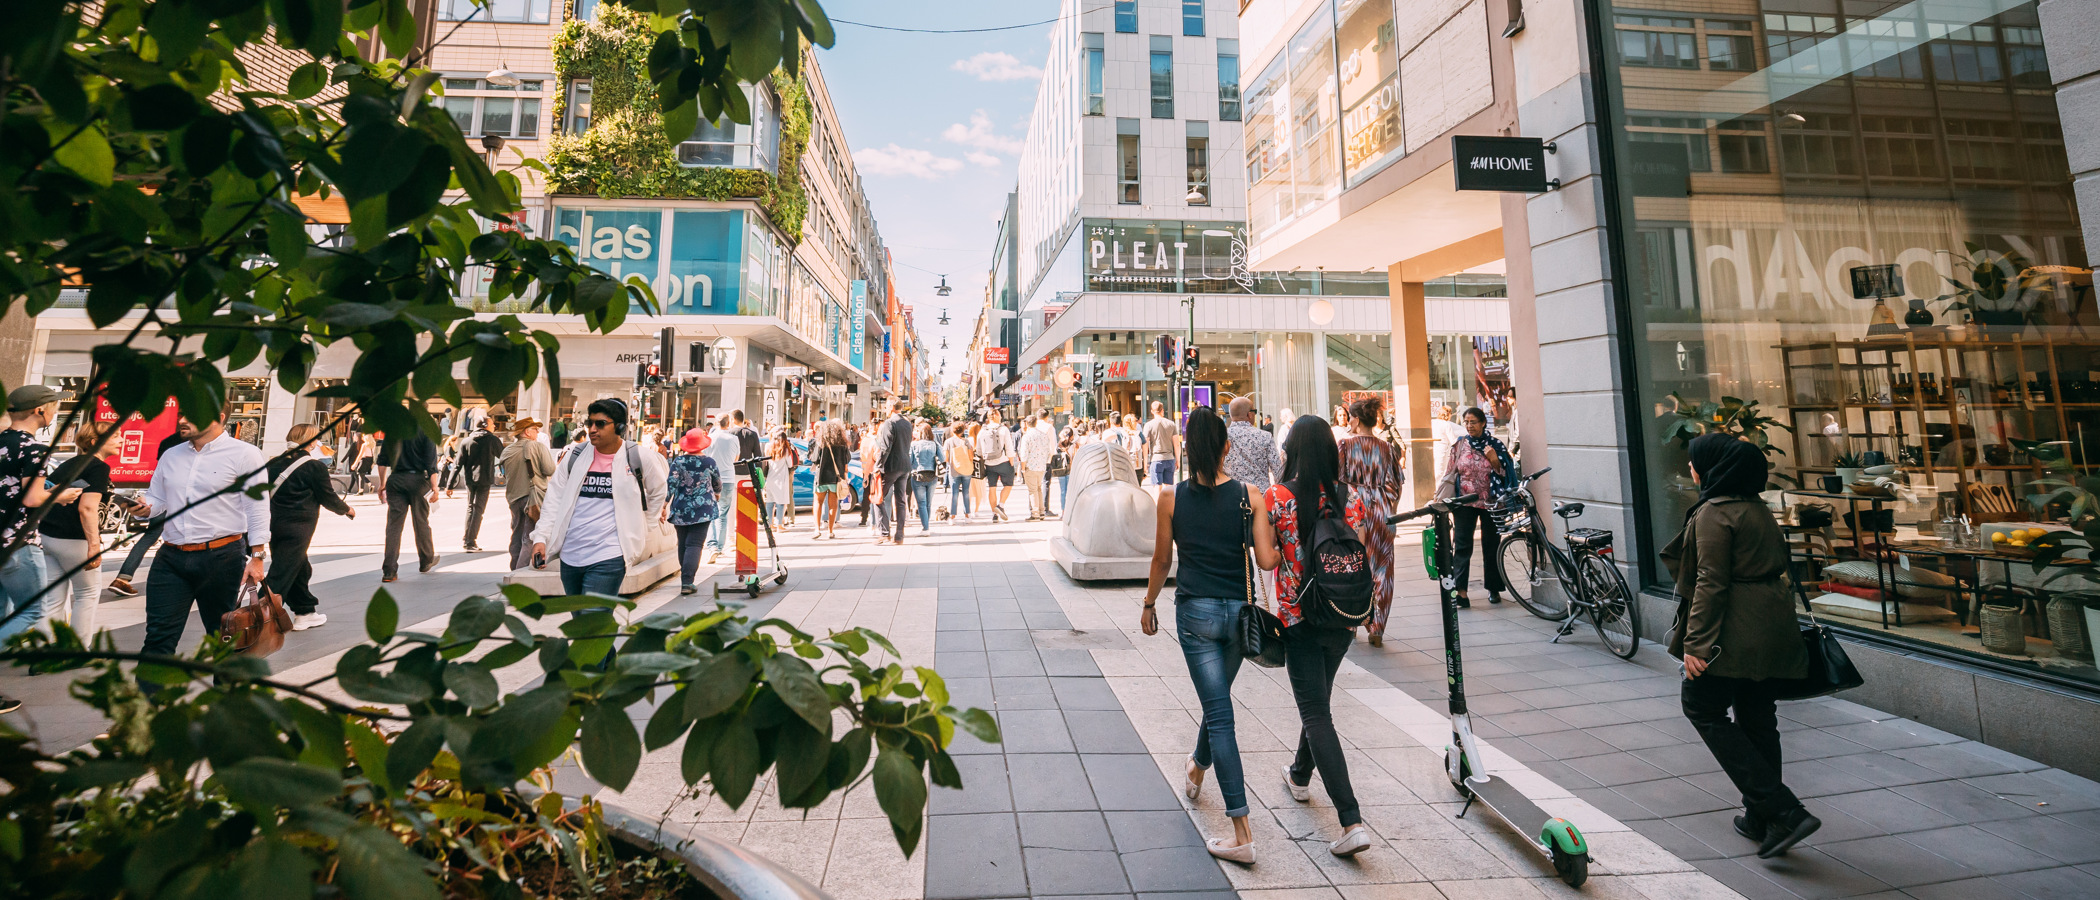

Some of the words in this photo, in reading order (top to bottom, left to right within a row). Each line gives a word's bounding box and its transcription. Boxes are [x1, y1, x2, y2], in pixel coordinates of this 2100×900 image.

[1489, 156, 1533, 171] HOME
[559, 215, 652, 260] clas
[1091, 240, 1188, 270] PLEAT
[852, 295, 864, 331] ohlson
[852, 332, 863, 354] clas
[616, 353, 652, 363] ARKET
